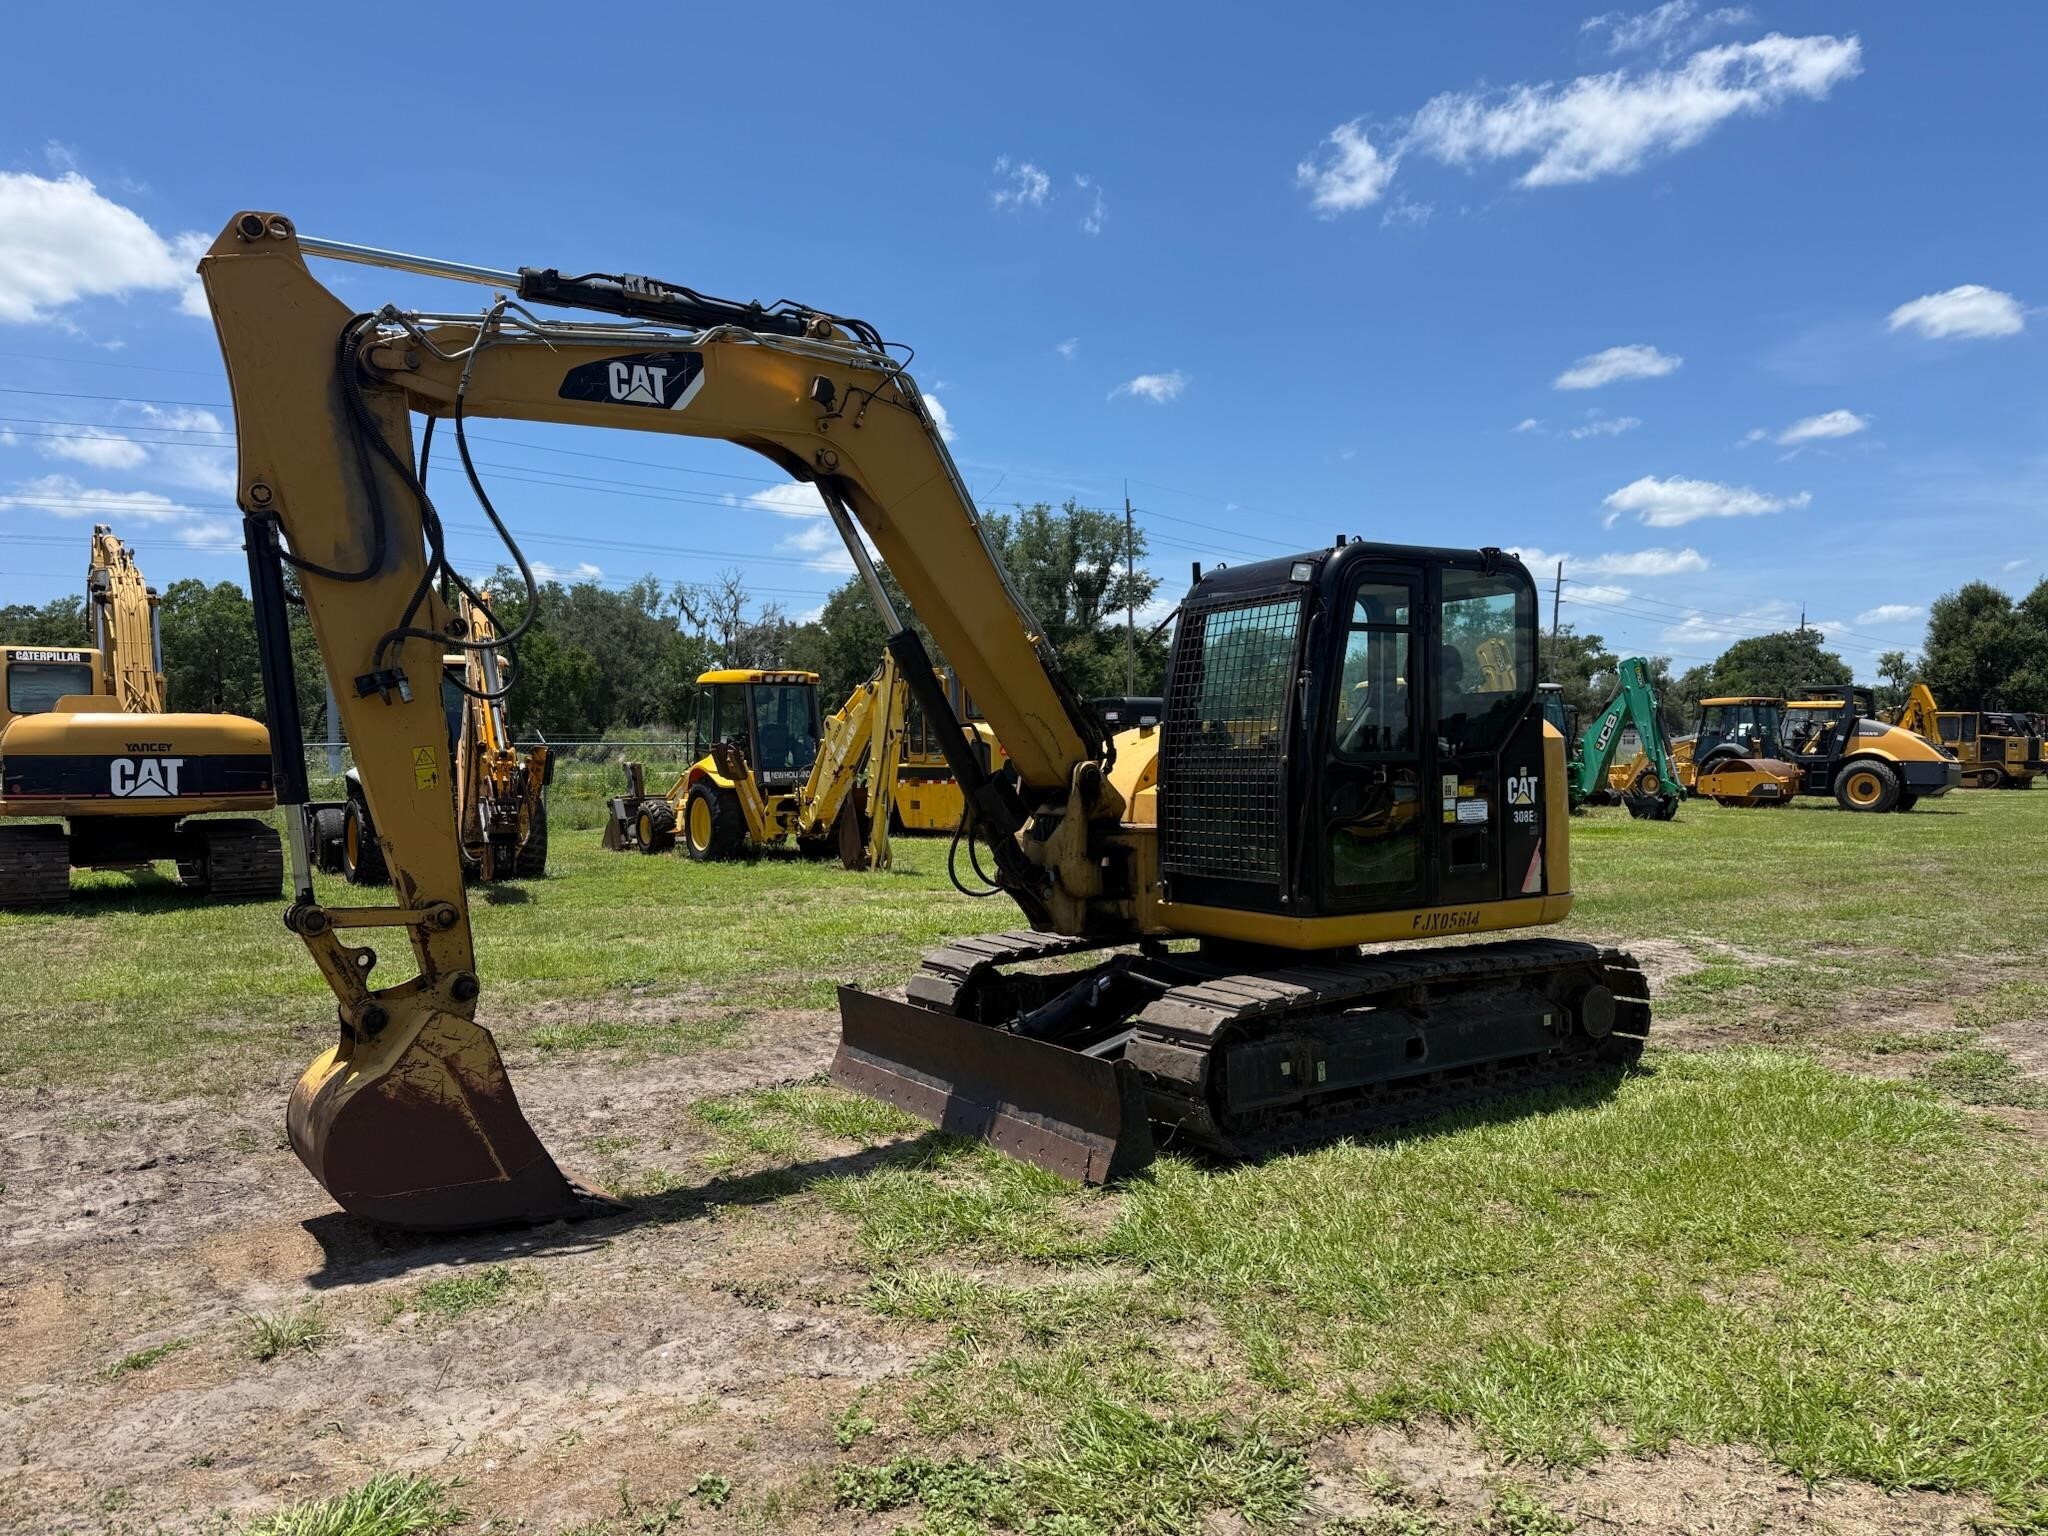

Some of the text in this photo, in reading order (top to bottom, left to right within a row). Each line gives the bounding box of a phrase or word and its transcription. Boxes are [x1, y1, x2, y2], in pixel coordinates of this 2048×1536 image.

[608, 362, 667, 404] CAT
[15, 650, 81, 662] CATERPILLAR
[125, 743, 172, 752] YANCEY
[1594, 713, 1618, 751] JCB
[110, 758, 183, 797] CAT
[1507, 776, 1538, 805] CAT
